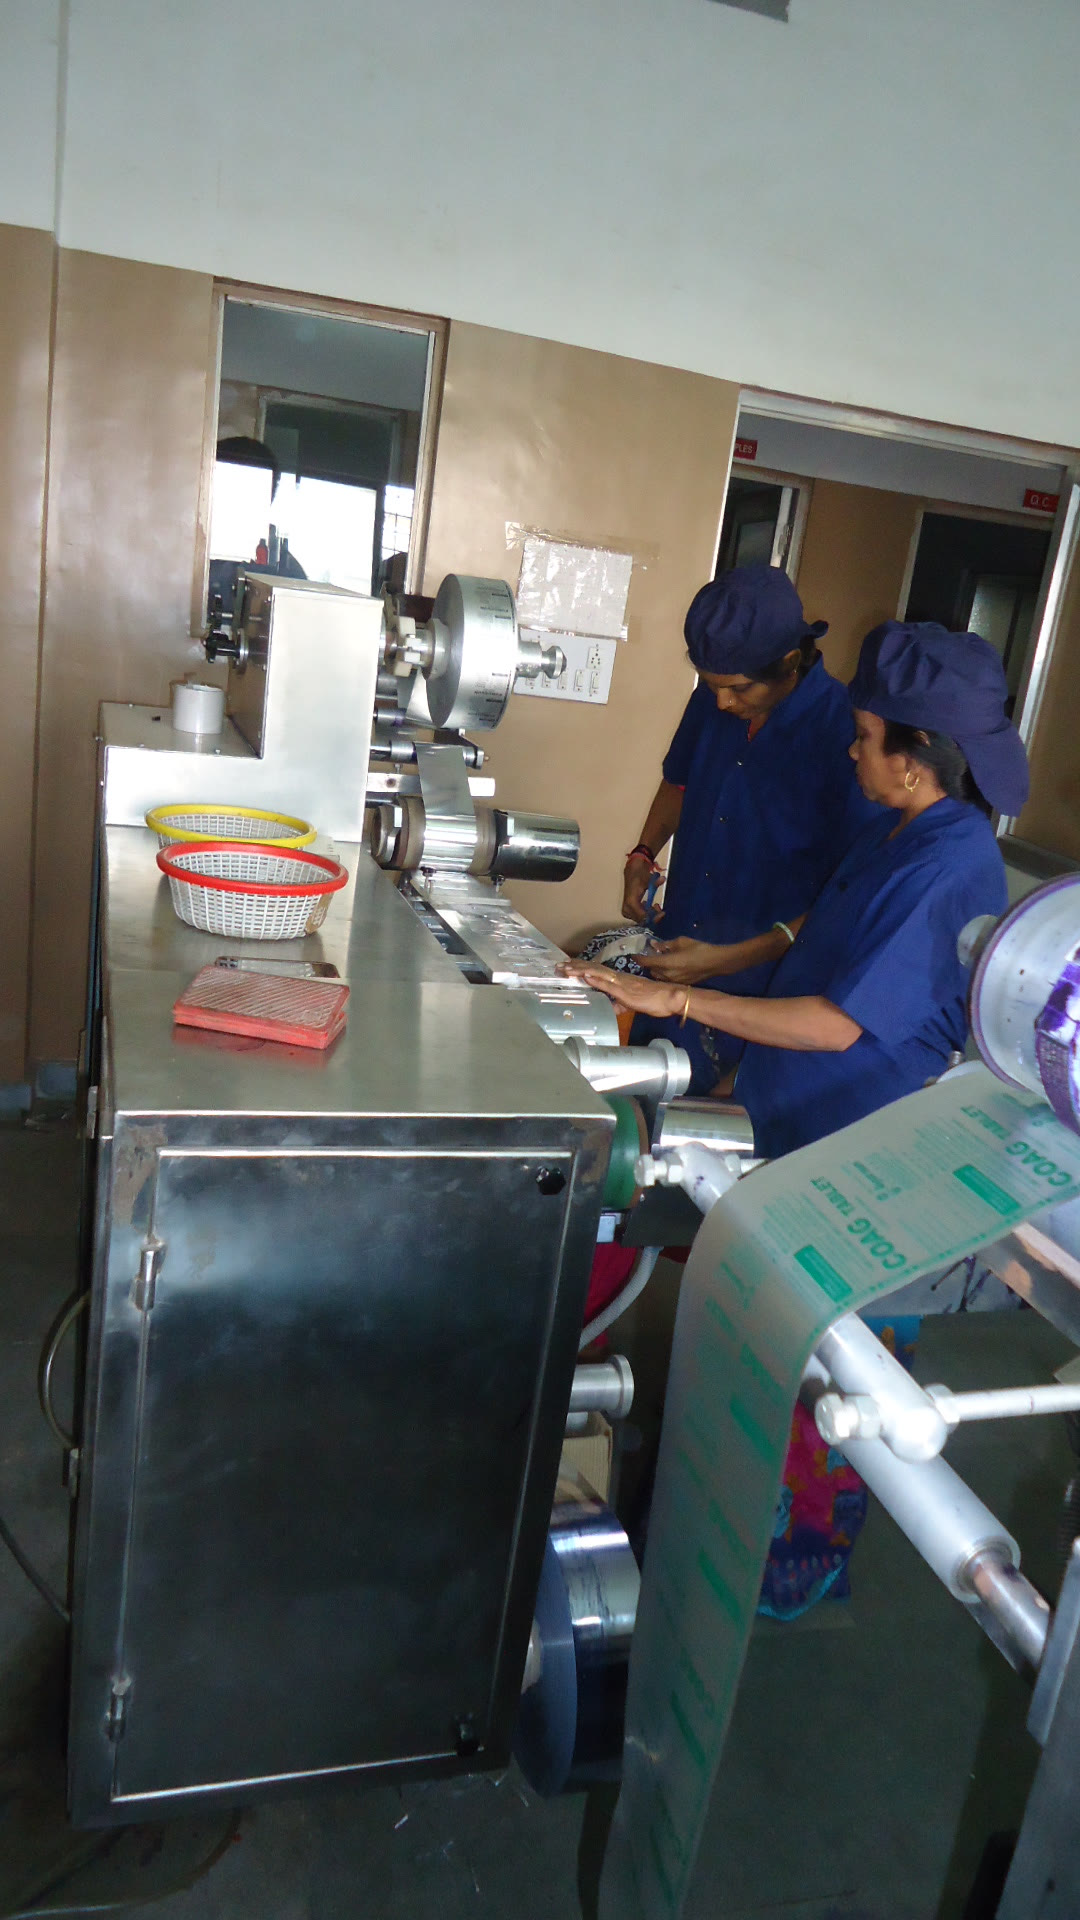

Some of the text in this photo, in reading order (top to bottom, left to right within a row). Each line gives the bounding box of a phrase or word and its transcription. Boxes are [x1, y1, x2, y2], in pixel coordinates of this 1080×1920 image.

[960, 1106, 1011, 1140] TABLET
[1005, 1141, 1072, 1186] COAG
[810, 1176, 854, 1216] TABLET
[847, 1218, 907, 1270] COAG
